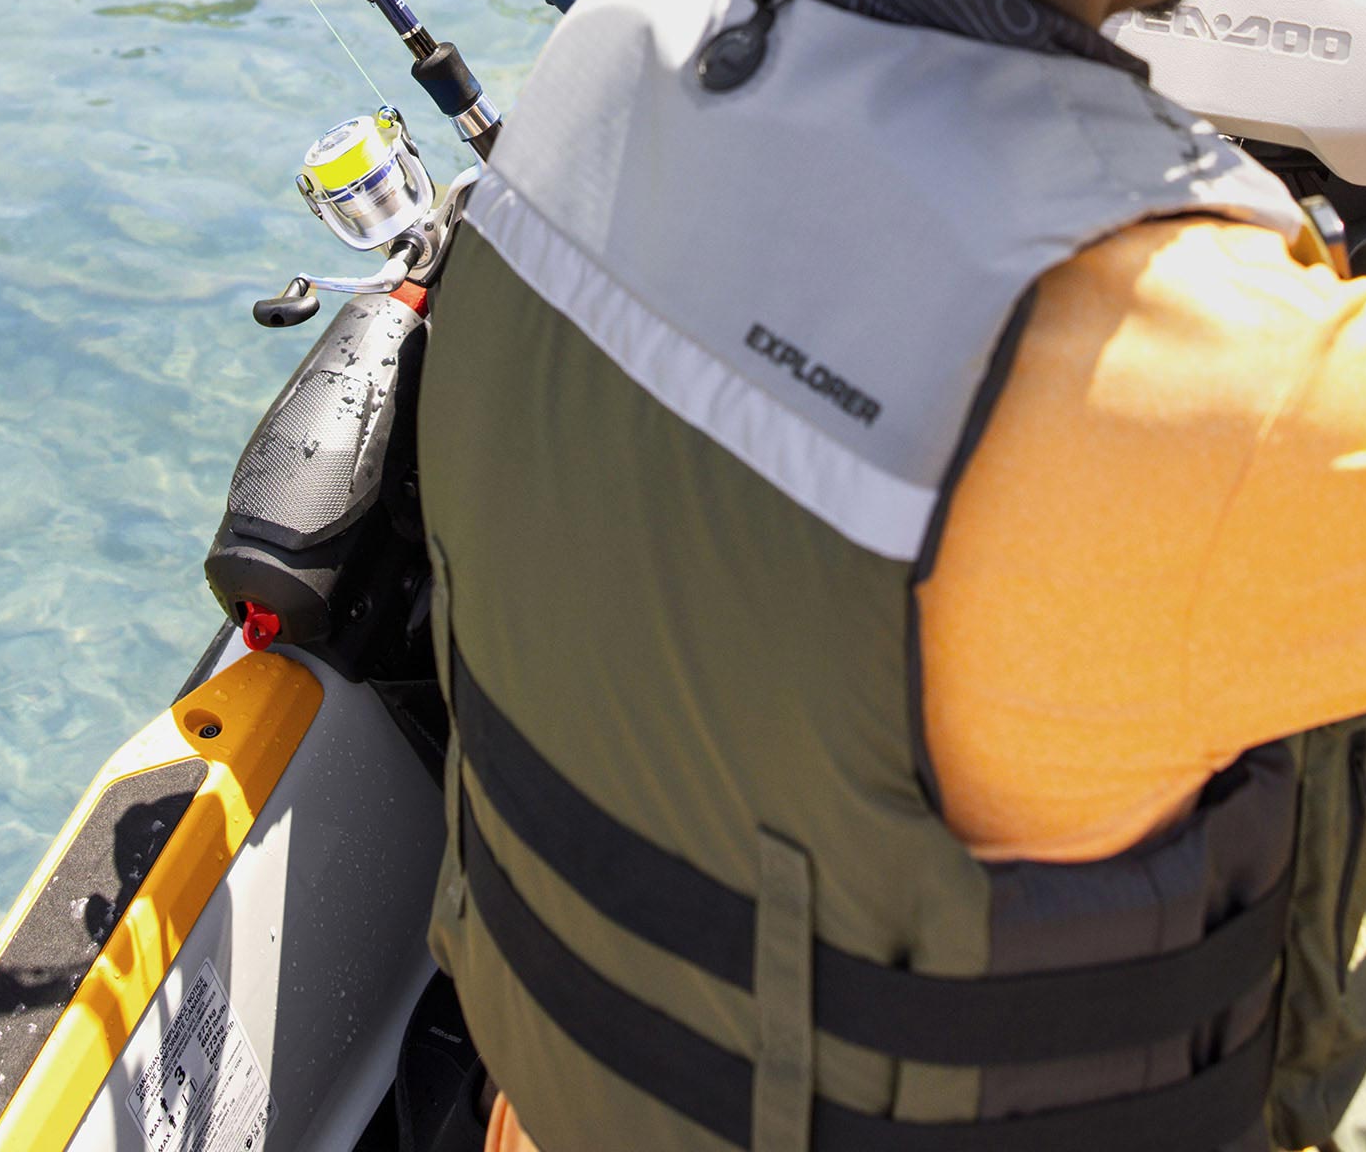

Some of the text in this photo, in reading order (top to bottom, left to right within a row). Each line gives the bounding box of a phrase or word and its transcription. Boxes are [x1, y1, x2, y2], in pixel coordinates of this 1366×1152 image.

[744, 321, 883, 428] EXPLORER
[135, 976, 204, 1096] CANADIAN COMPLIANCE NOTICE
[197, 1008, 217, 1042] 273 kg
[201, 1026, 213, 1048] 602
[139, 1083, 150, 1103] AVIS
[149, 1073, 157, 1085] DE
[184, 981, 208, 1021] CANADIEN
[204, 1024, 225, 1058] 273 kg
[209, 1043, 220, 1065] 602
[174, 1065, 186, 1086] 3
[214, 1062, 220, 1072] C
[149, 1117, 164, 1139] MAX.
